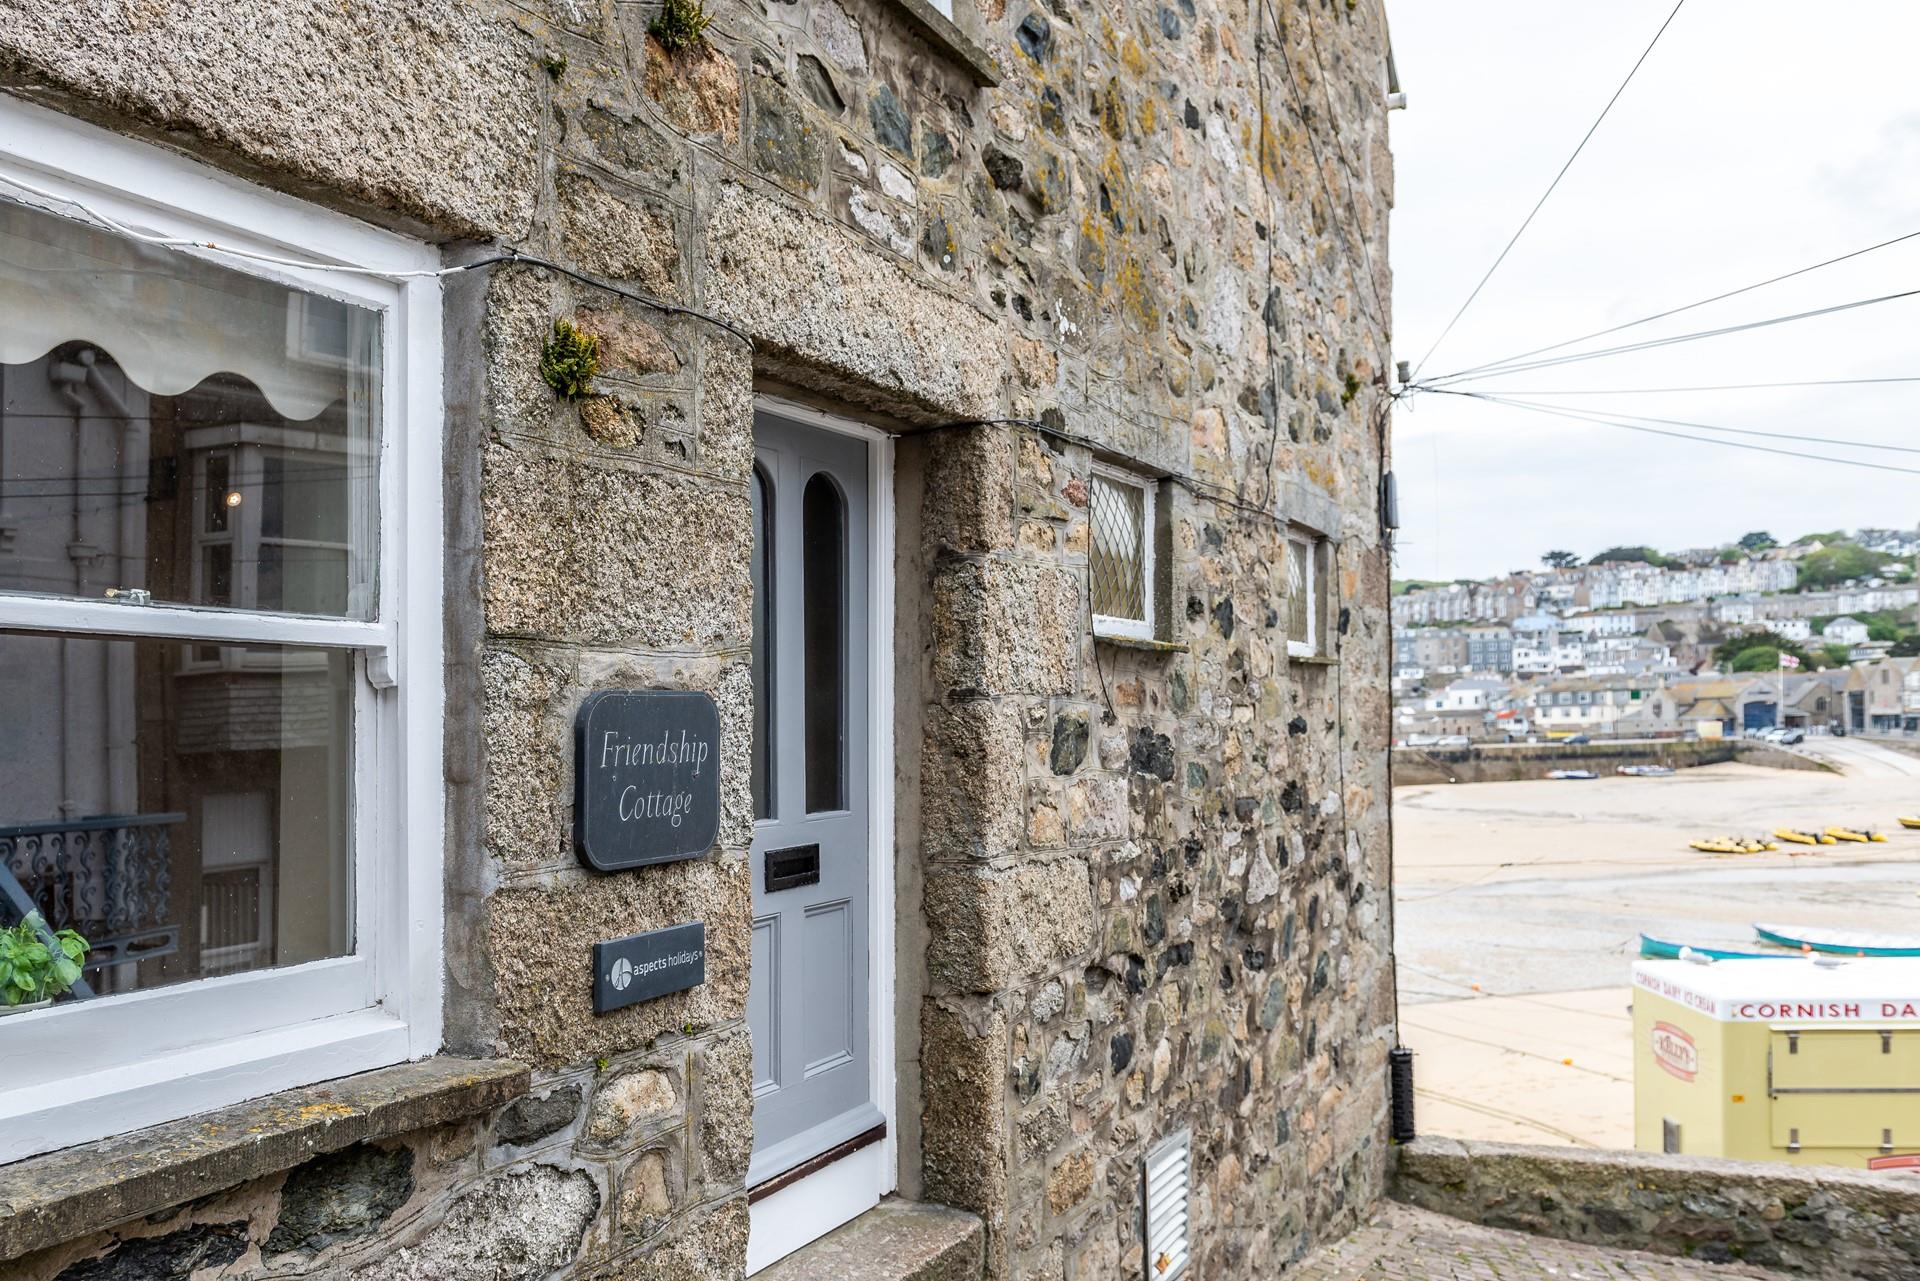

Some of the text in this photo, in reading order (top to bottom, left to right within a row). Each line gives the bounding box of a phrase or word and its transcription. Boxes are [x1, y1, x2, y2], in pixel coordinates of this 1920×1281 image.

[600, 729, 708, 775] Friendship
[619, 785, 693, 828] Cottage
[633, 949, 699, 977] aspects holidays
[1740, 1003, 1860, 1018] CORNISH
